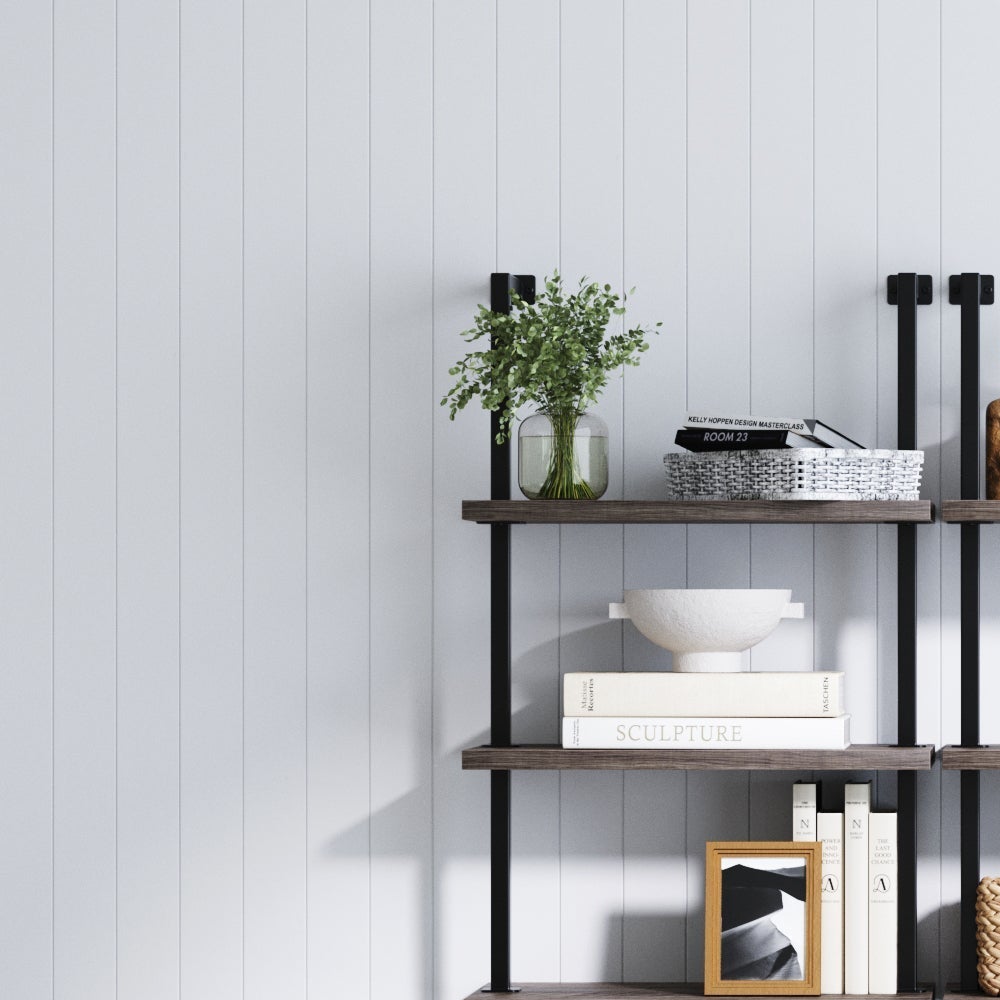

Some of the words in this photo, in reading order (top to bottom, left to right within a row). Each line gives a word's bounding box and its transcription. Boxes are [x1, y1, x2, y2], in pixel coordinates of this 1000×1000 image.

[708, 417, 733, 425] HOPPEN
[734, 419, 757, 427] DESIGN
[758, 421, 804, 430] MASTERCLASS
[703, 432, 734, 442] ROOM
[735, 432, 749, 442] 23
[616, 724, 742, 742] SCULPTURE
[800, 819, 809, 829] N
[852, 819, 862, 829] N
